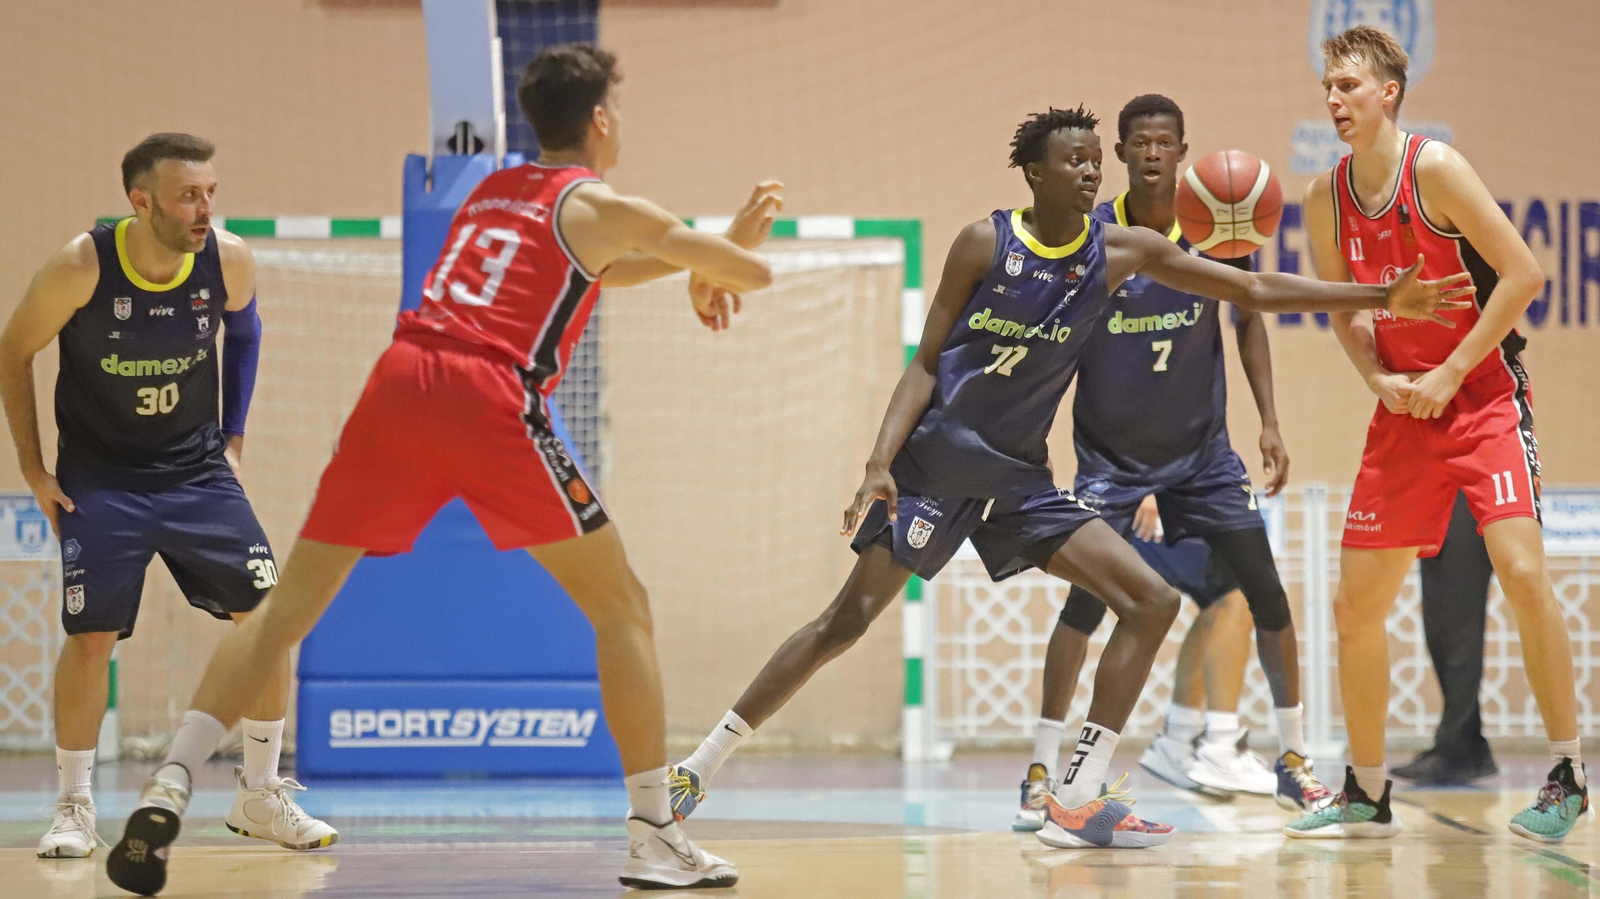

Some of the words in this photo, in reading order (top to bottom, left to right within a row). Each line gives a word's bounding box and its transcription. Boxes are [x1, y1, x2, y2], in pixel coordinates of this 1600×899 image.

[423, 223, 521, 307] 13
[1349, 237, 1365, 261] 11
[1152, 339, 1173, 372] 7
[136, 382, 180, 415] 30
[1491, 470, 1518, 506] 11
[246, 558, 279, 590] 30
